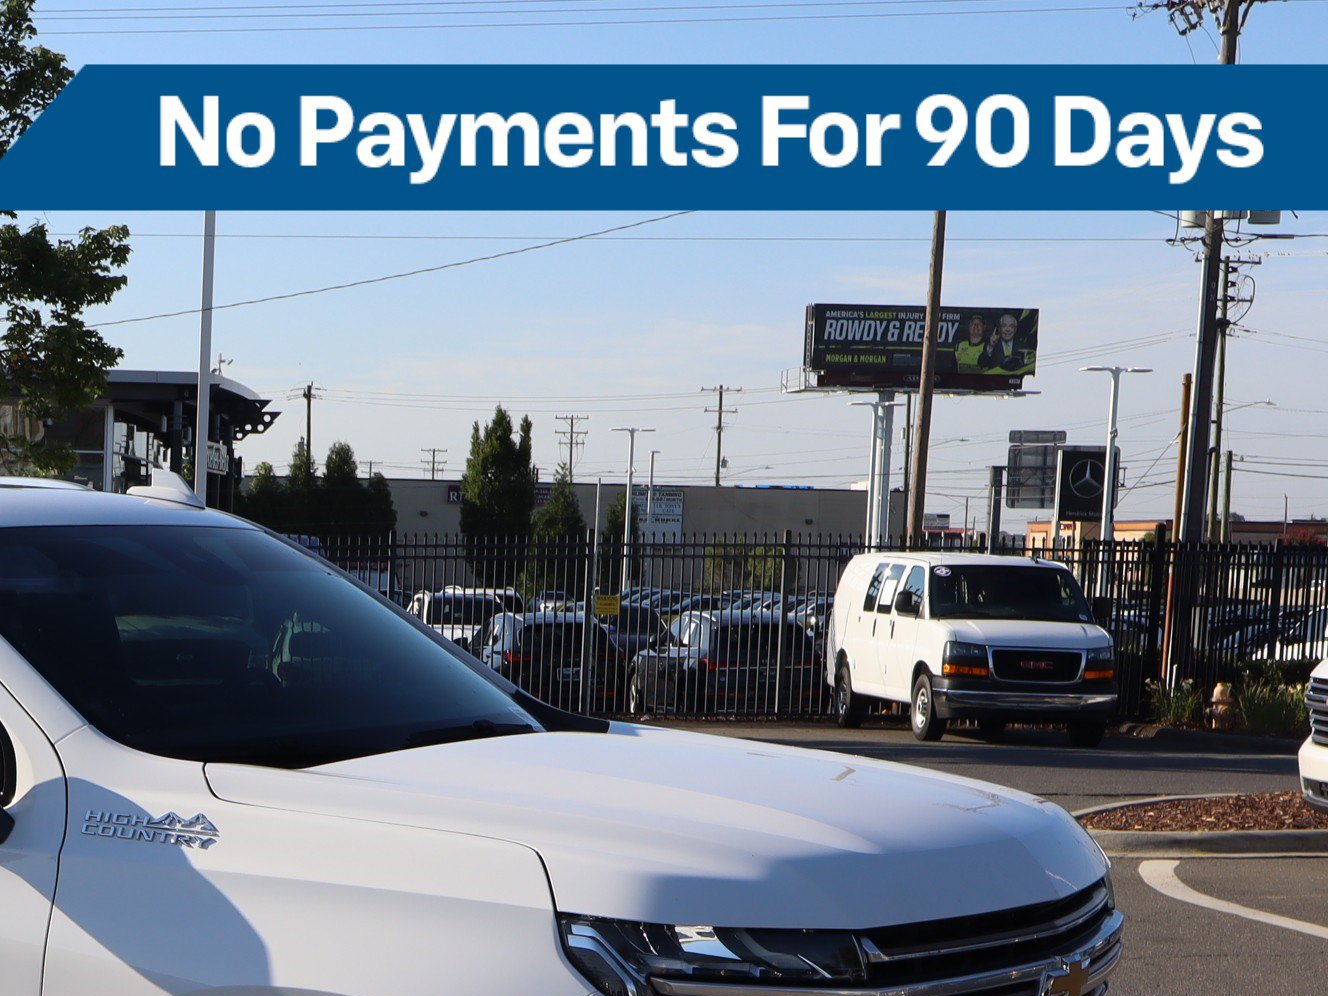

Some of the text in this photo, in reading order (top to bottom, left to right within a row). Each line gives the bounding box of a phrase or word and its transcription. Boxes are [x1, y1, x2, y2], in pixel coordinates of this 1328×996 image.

[826, 310, 865, 318] AMERICA'S
[865, 311, 897, 319] LARGEST
[898, 312, 925, 320] INJURY
[942, 313, 960, 321] FIRM
[824, 320, 959, 343] ROWDY & REDY
[825, 353, 853, 363] MORGAN
[854, 354, 859, 363] &
[859, 354, 887, 364] MORGAN
[1020, 661, 1054, 670] GMC
[85, 810, 150, 827] HIGH
[81, 823, 218, 850] COUNTRY
